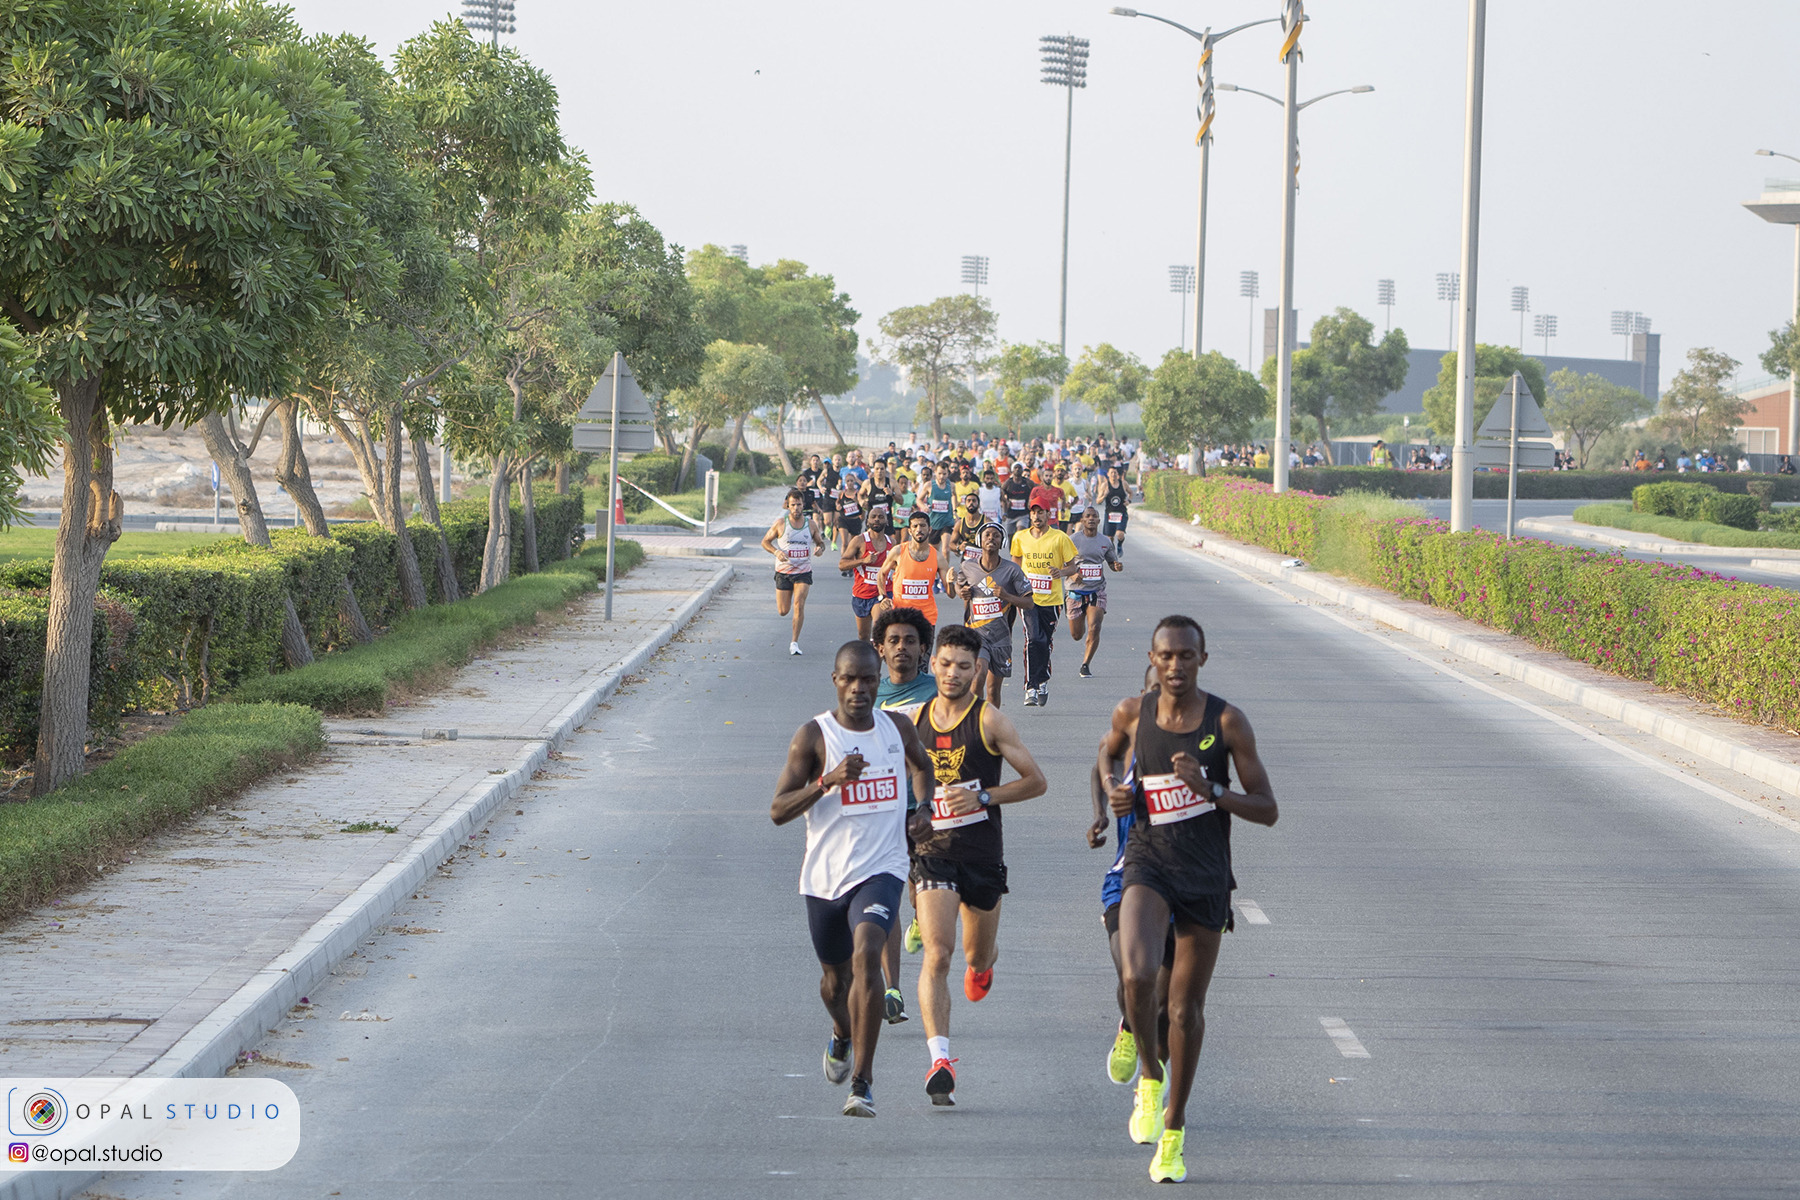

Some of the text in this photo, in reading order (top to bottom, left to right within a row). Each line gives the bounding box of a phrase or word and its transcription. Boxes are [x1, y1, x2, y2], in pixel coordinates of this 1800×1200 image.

[1081, 569, 1100, 577] 10193
[904, 585, 928, 595] 10070
[974, 603, 1000, 614] 10203
[845, 779, 895, 803] 10155
[1150, 786, 1204, 812] 1002
